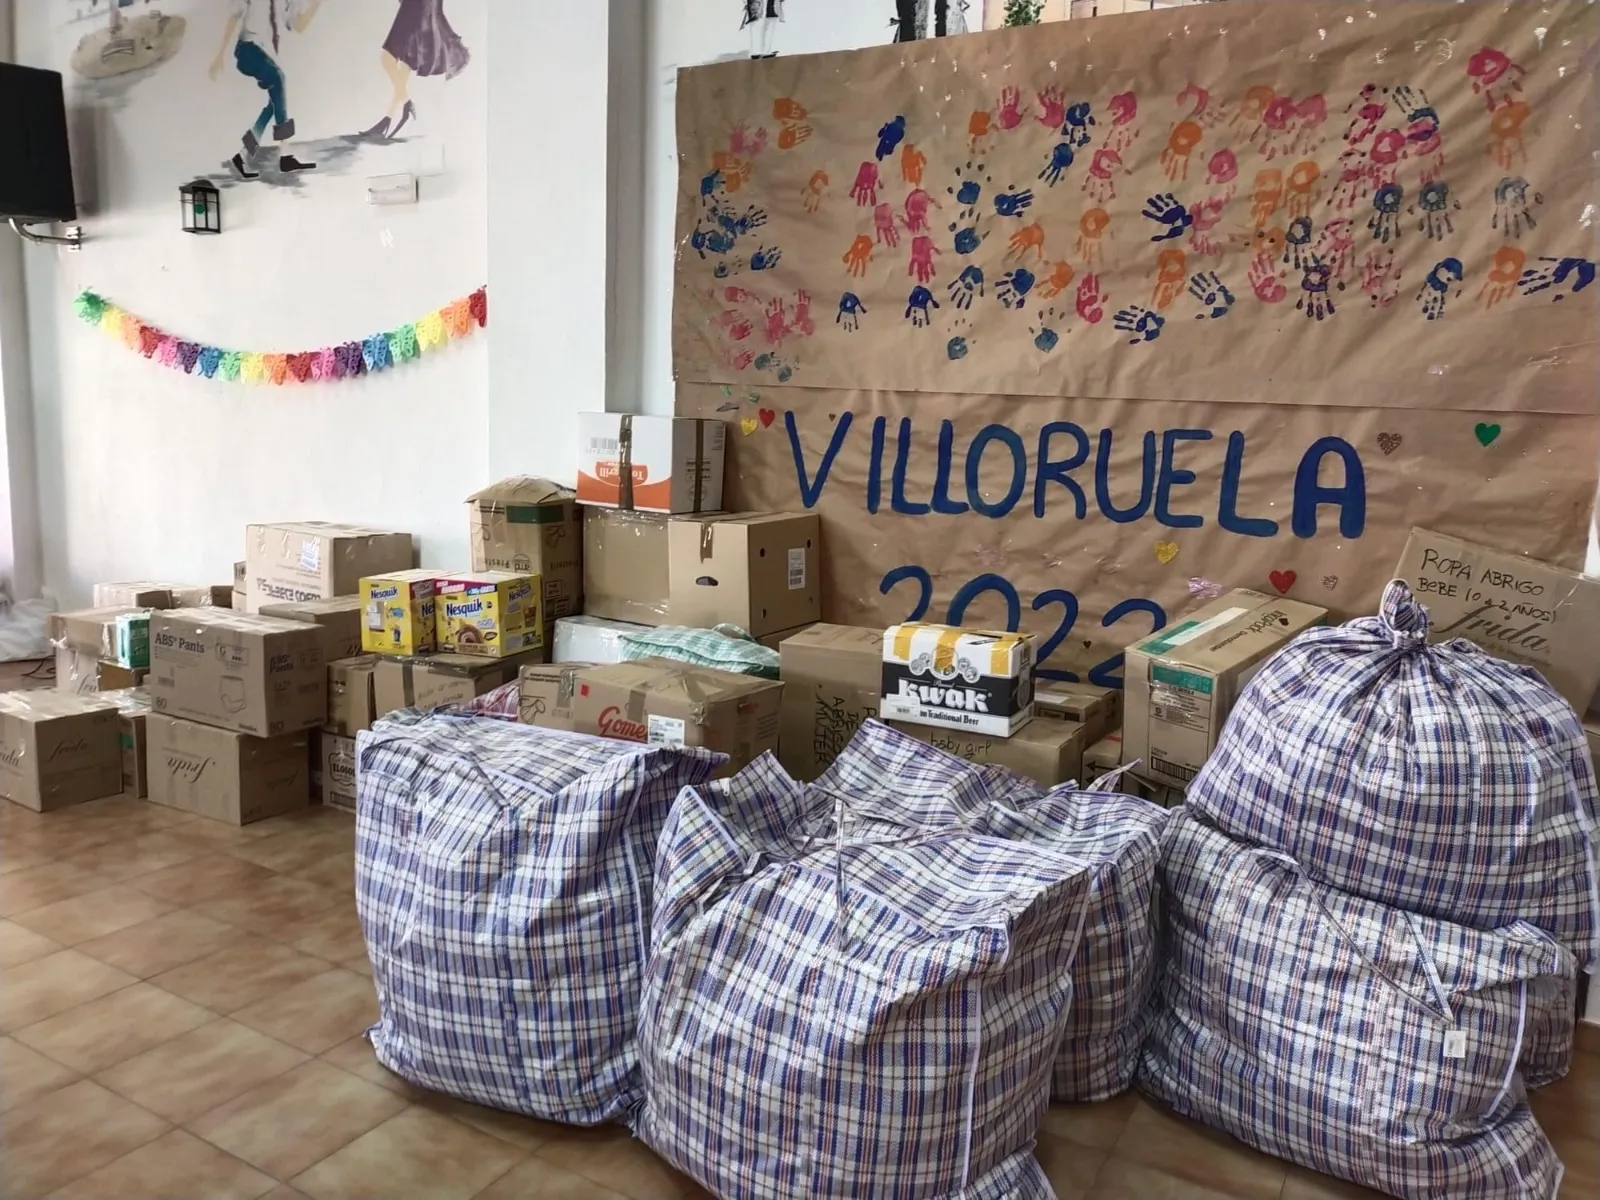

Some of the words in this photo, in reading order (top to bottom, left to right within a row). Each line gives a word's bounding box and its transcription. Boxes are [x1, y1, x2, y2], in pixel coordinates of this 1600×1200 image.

[784, 411, 1366, 538] VILLORUELA
[1421, 548, 1473, 580] ROPA
[1480, 568, 1544, 596] ABRIGO
[371, 586, 398, 599] Nesquik
[446, 598, 483, 618] Nesquik
[179, 637, 205, 653] Pants
[598, 706, 649, 738] Gome
[928, 709, 962, 723] Traditional
[963, 715, 979, 725] Beer
[930, 731, 960, 755] baby
[964, 739, 992, 760] girl
[167, 757, 216, 783] frida
